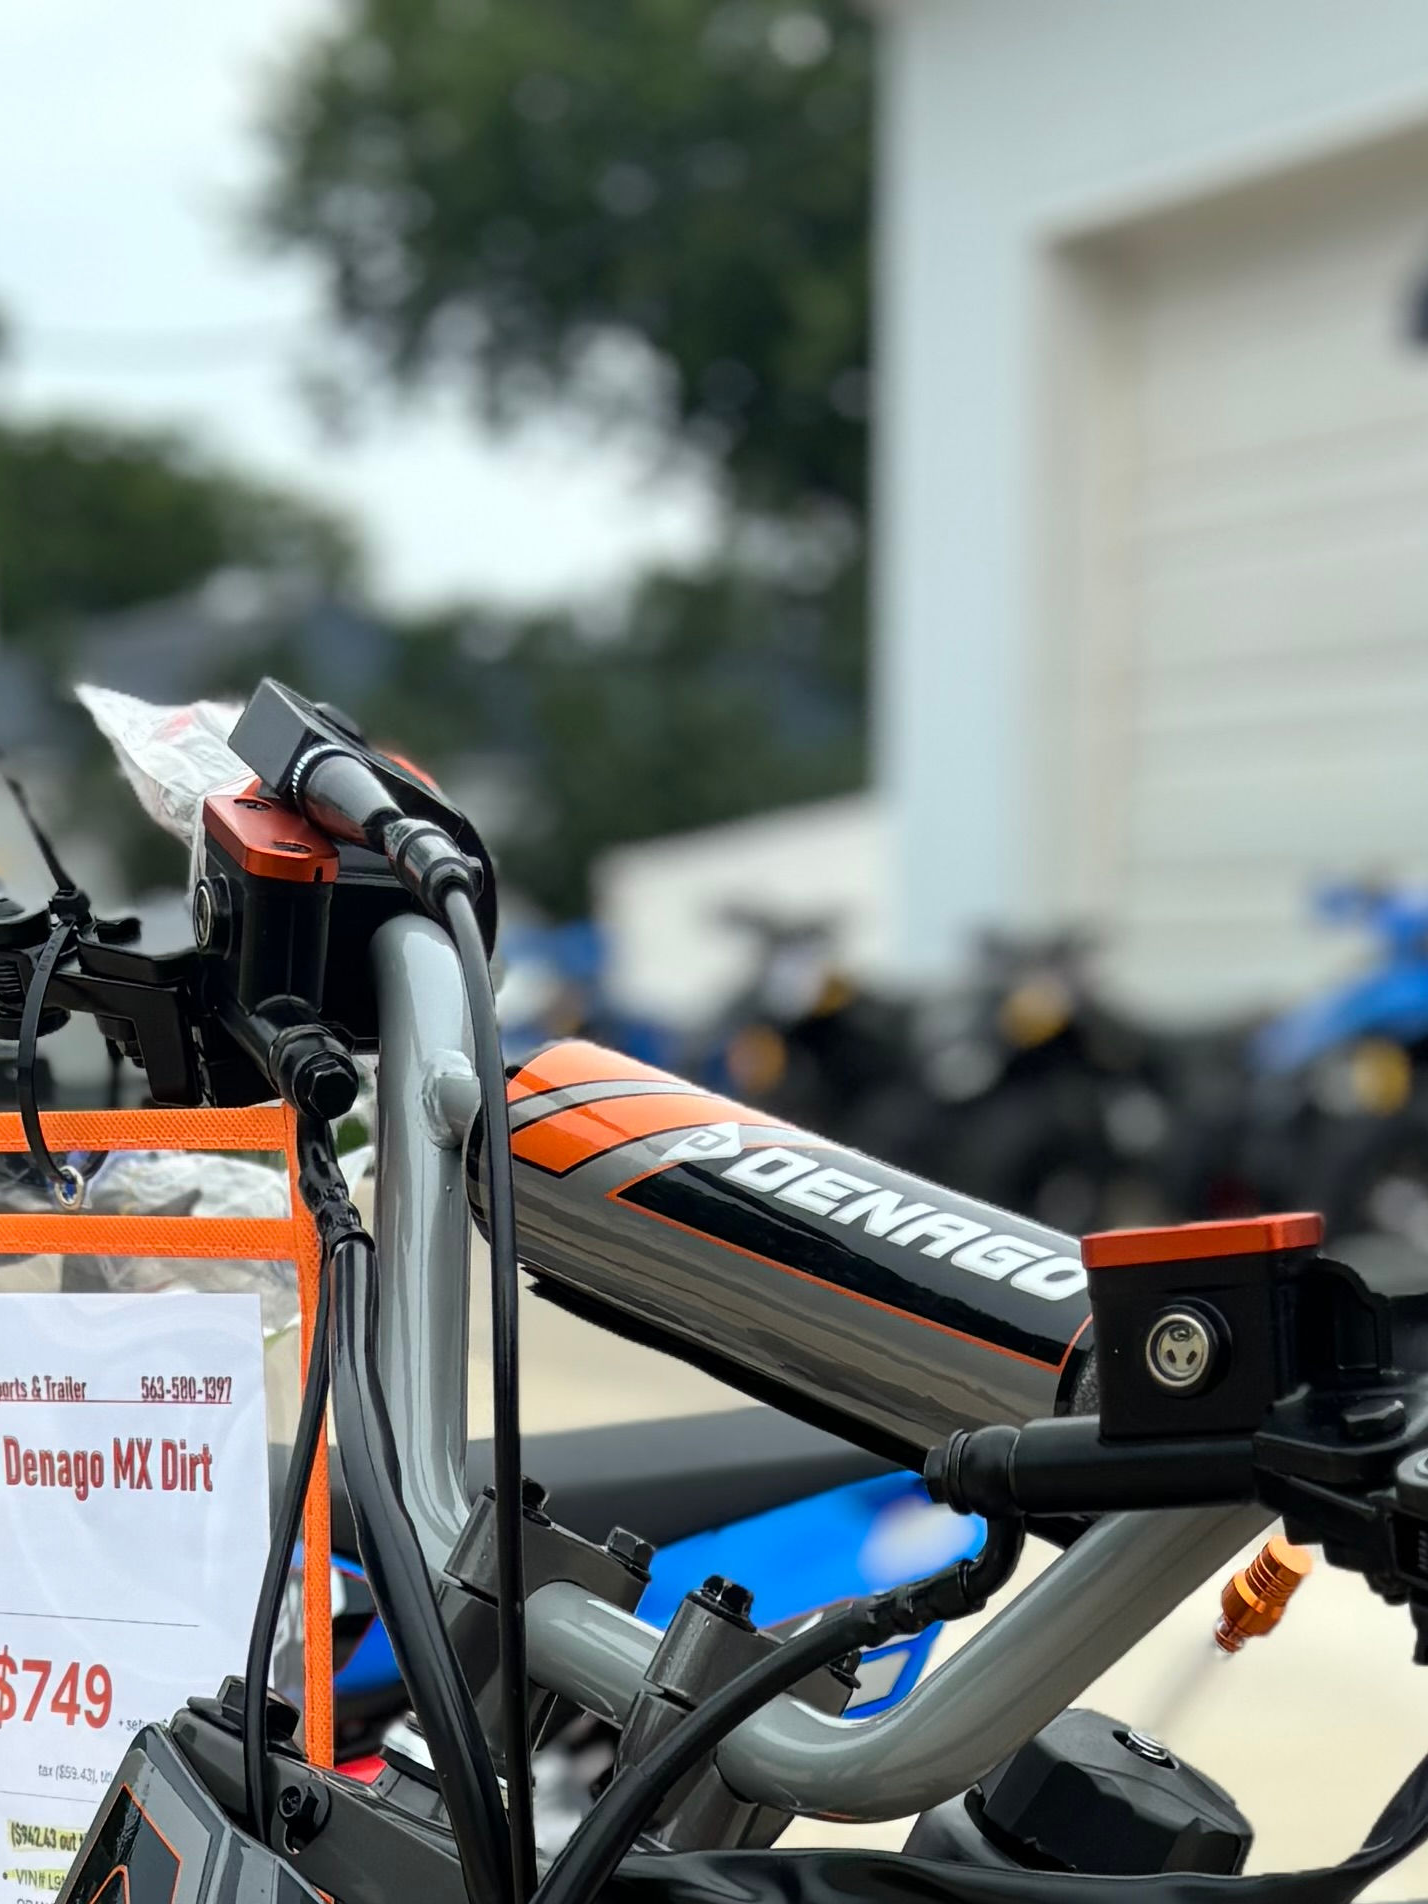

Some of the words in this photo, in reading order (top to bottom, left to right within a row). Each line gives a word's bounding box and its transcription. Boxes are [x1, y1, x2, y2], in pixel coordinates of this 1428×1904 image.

[721, 1147, 1089, 1302] DENAGO
[32, 1375, 41, 1399] &
[44, 1376, 87, 1400] Trailer
[141, 1376, 233, 1402] 563-580-1397
[3, 1435, 105, 1502] Denago
[113, 1437, 154, 1490] MX
[161, 1439, 214, 1492] Dirt
